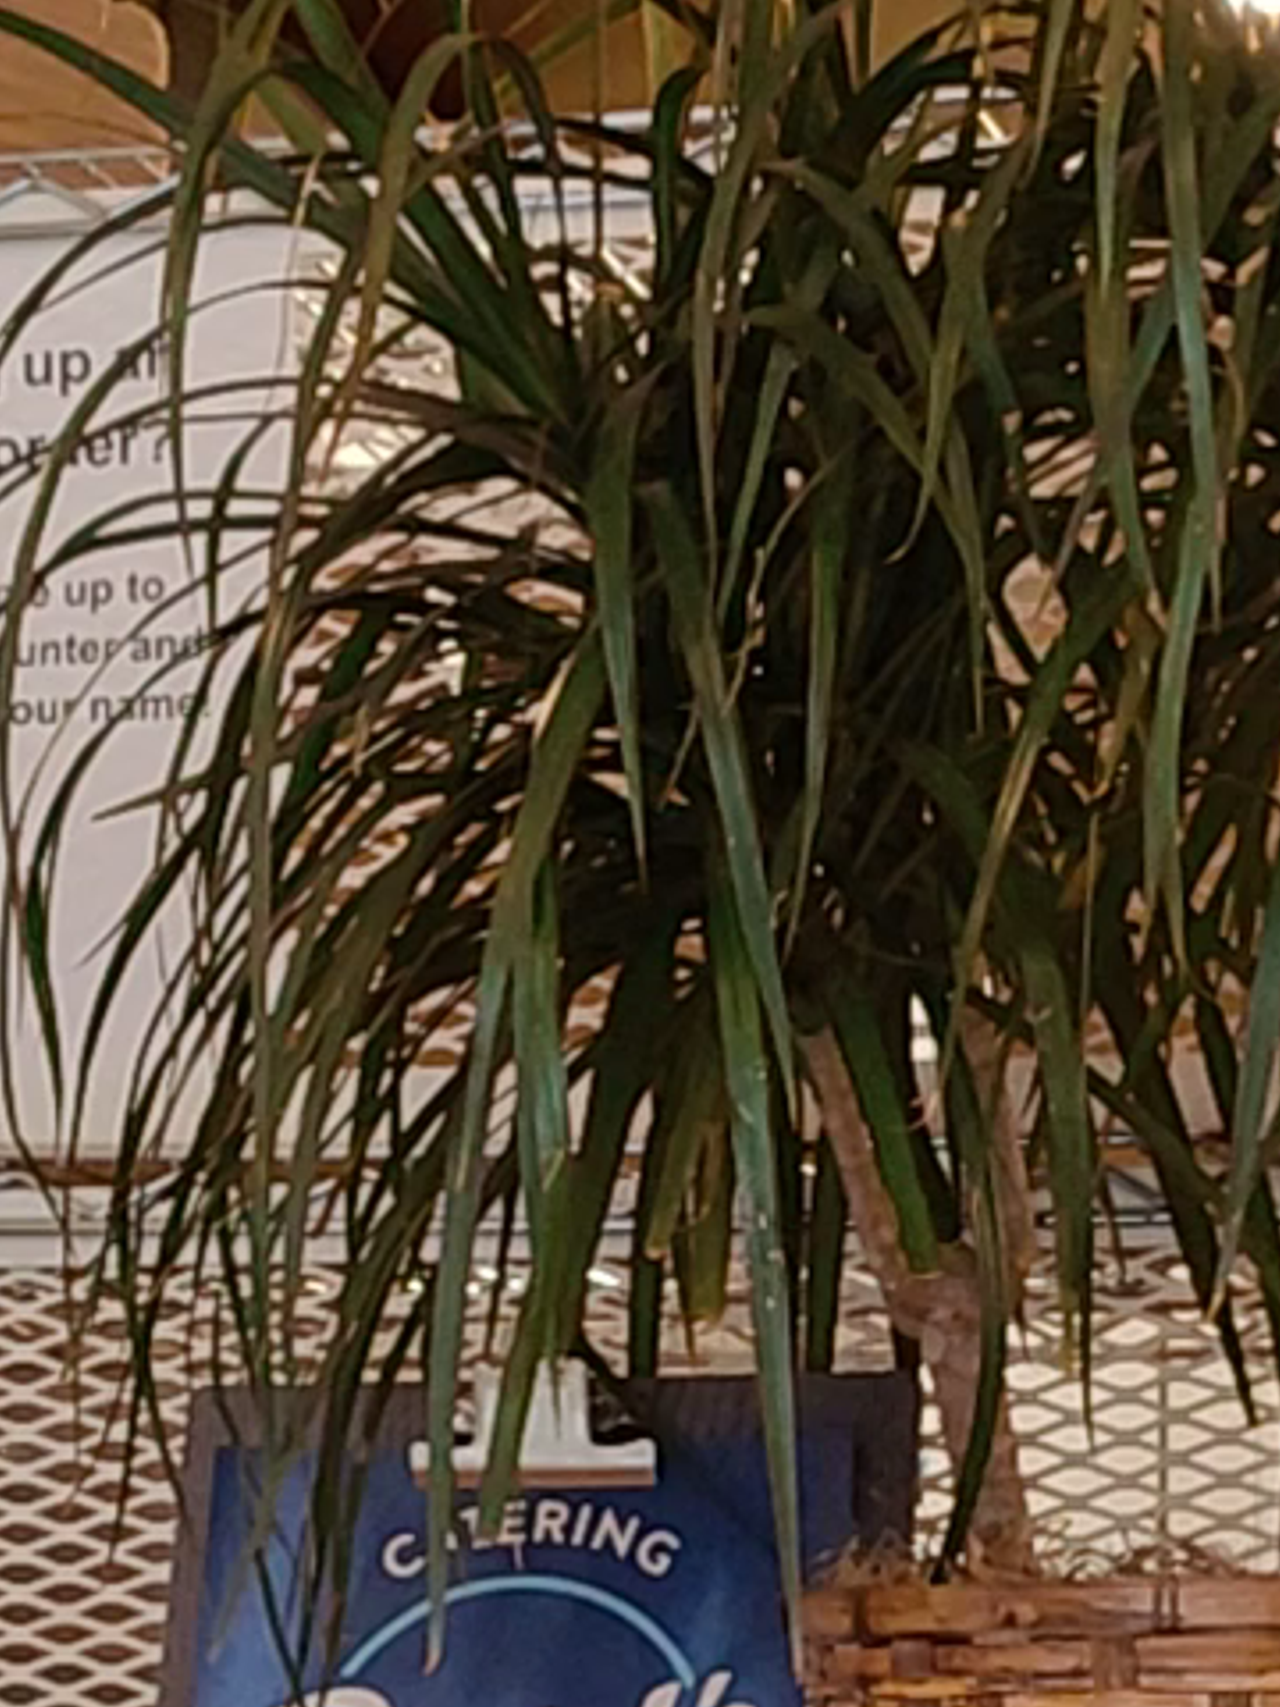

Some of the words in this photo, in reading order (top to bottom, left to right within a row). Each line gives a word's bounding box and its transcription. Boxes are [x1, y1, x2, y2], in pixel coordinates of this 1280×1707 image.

[24, 348, 92, 397] up
[64, 581, 114, 614] up
[127, 572, 165, 603] to
[382, 1498, 682, 1579] CTERING
